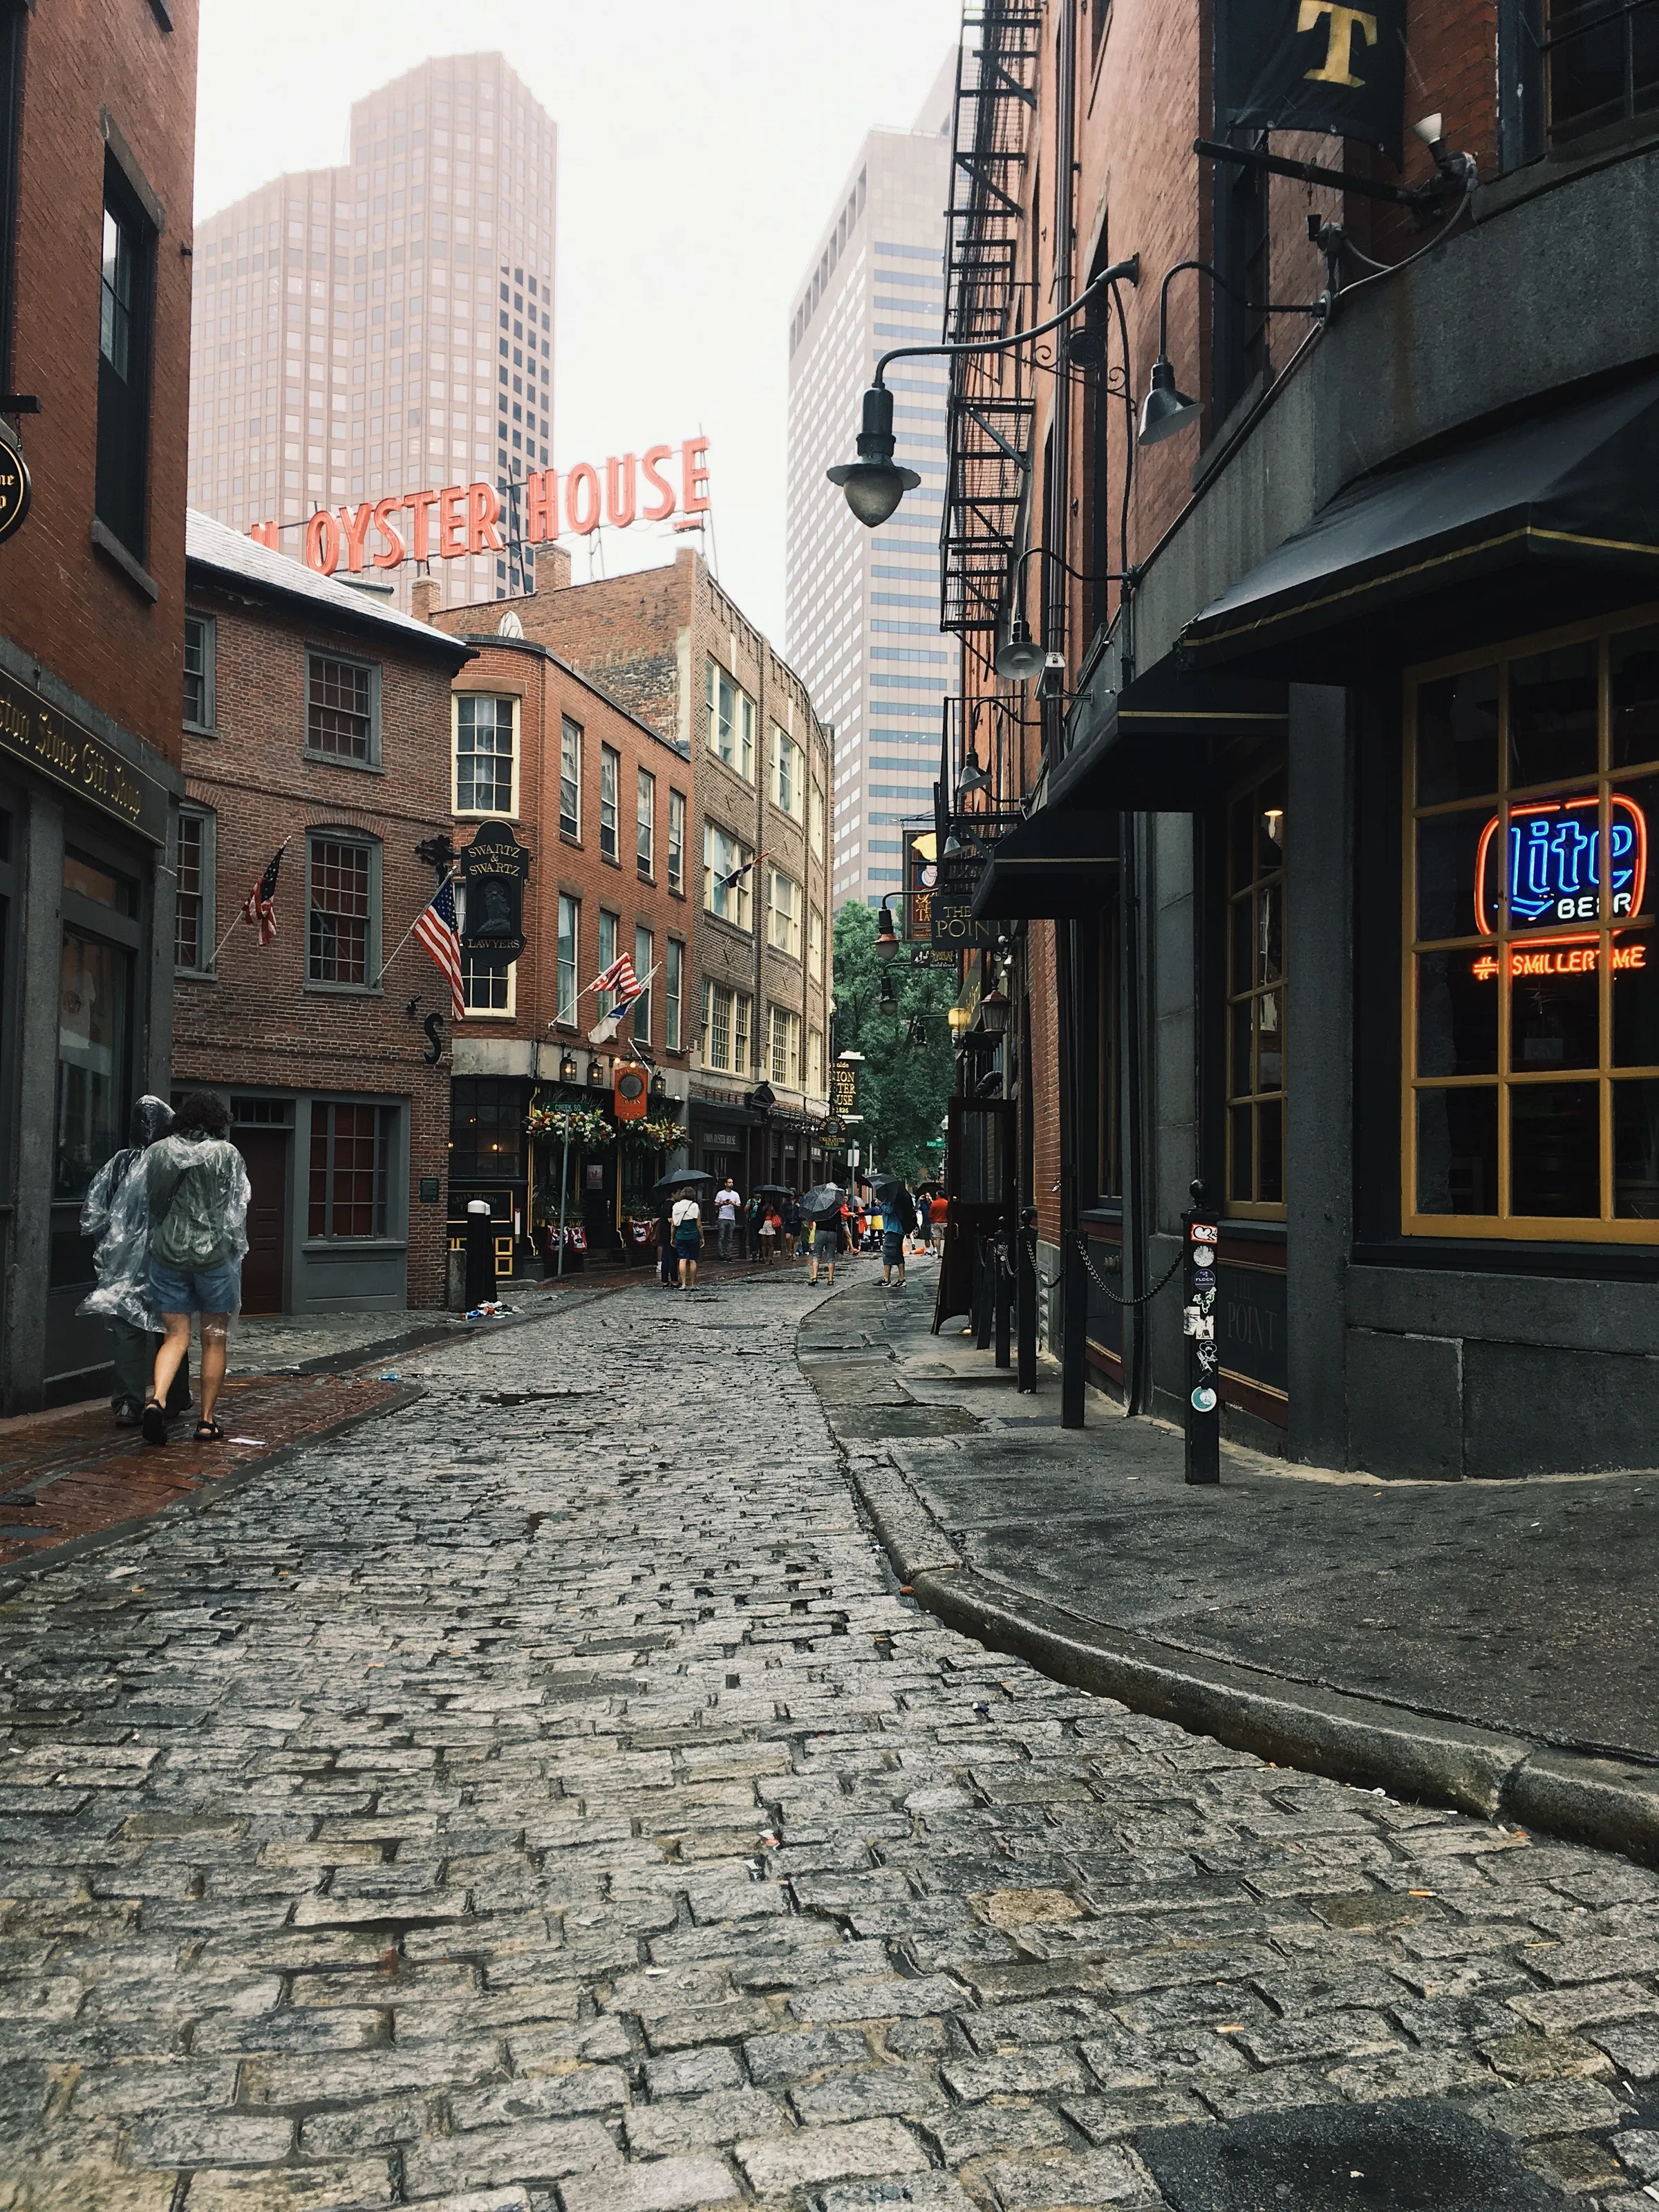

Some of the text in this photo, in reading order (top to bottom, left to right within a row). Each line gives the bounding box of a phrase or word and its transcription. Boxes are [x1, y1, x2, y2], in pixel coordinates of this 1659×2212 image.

[306, 436, 711, 576] OYSTER HOUSE
[82, 742, 109, 795] Gift
[468, 844, 521, 859] SWARTZ
[490, 854, 499, 863] &
[469, 863, 521, 877] SWARTZ
[943, 906, 972, 918] THE
[1557, 892, 1633, 919] BER
[468, 939, 520, 949] LAWYERS
[1472, 946, 1646, 980] #SMILLERME
[830, 1071, 855, 1082] ION
[1228, 1302, 1278, 1353] POINT
